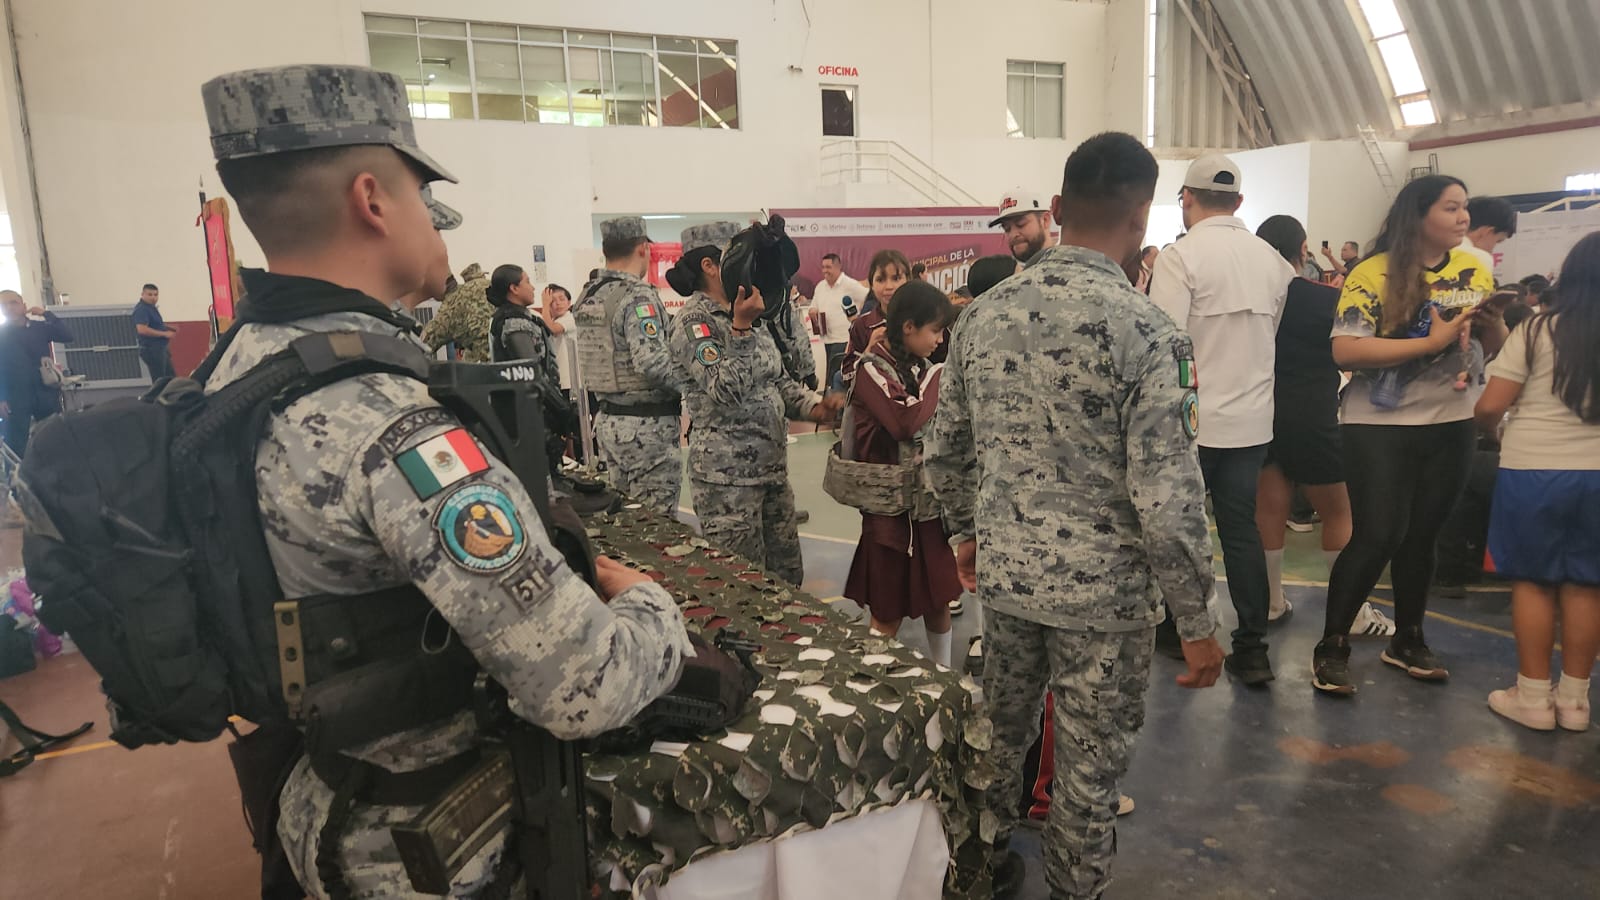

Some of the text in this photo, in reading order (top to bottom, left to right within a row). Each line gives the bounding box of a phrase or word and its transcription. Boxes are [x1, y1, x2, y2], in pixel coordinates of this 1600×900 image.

[818, 65, 858, 77] OFICINA
[950, 250, 962, 262] DE
[964, 247, 975, 258] LA
